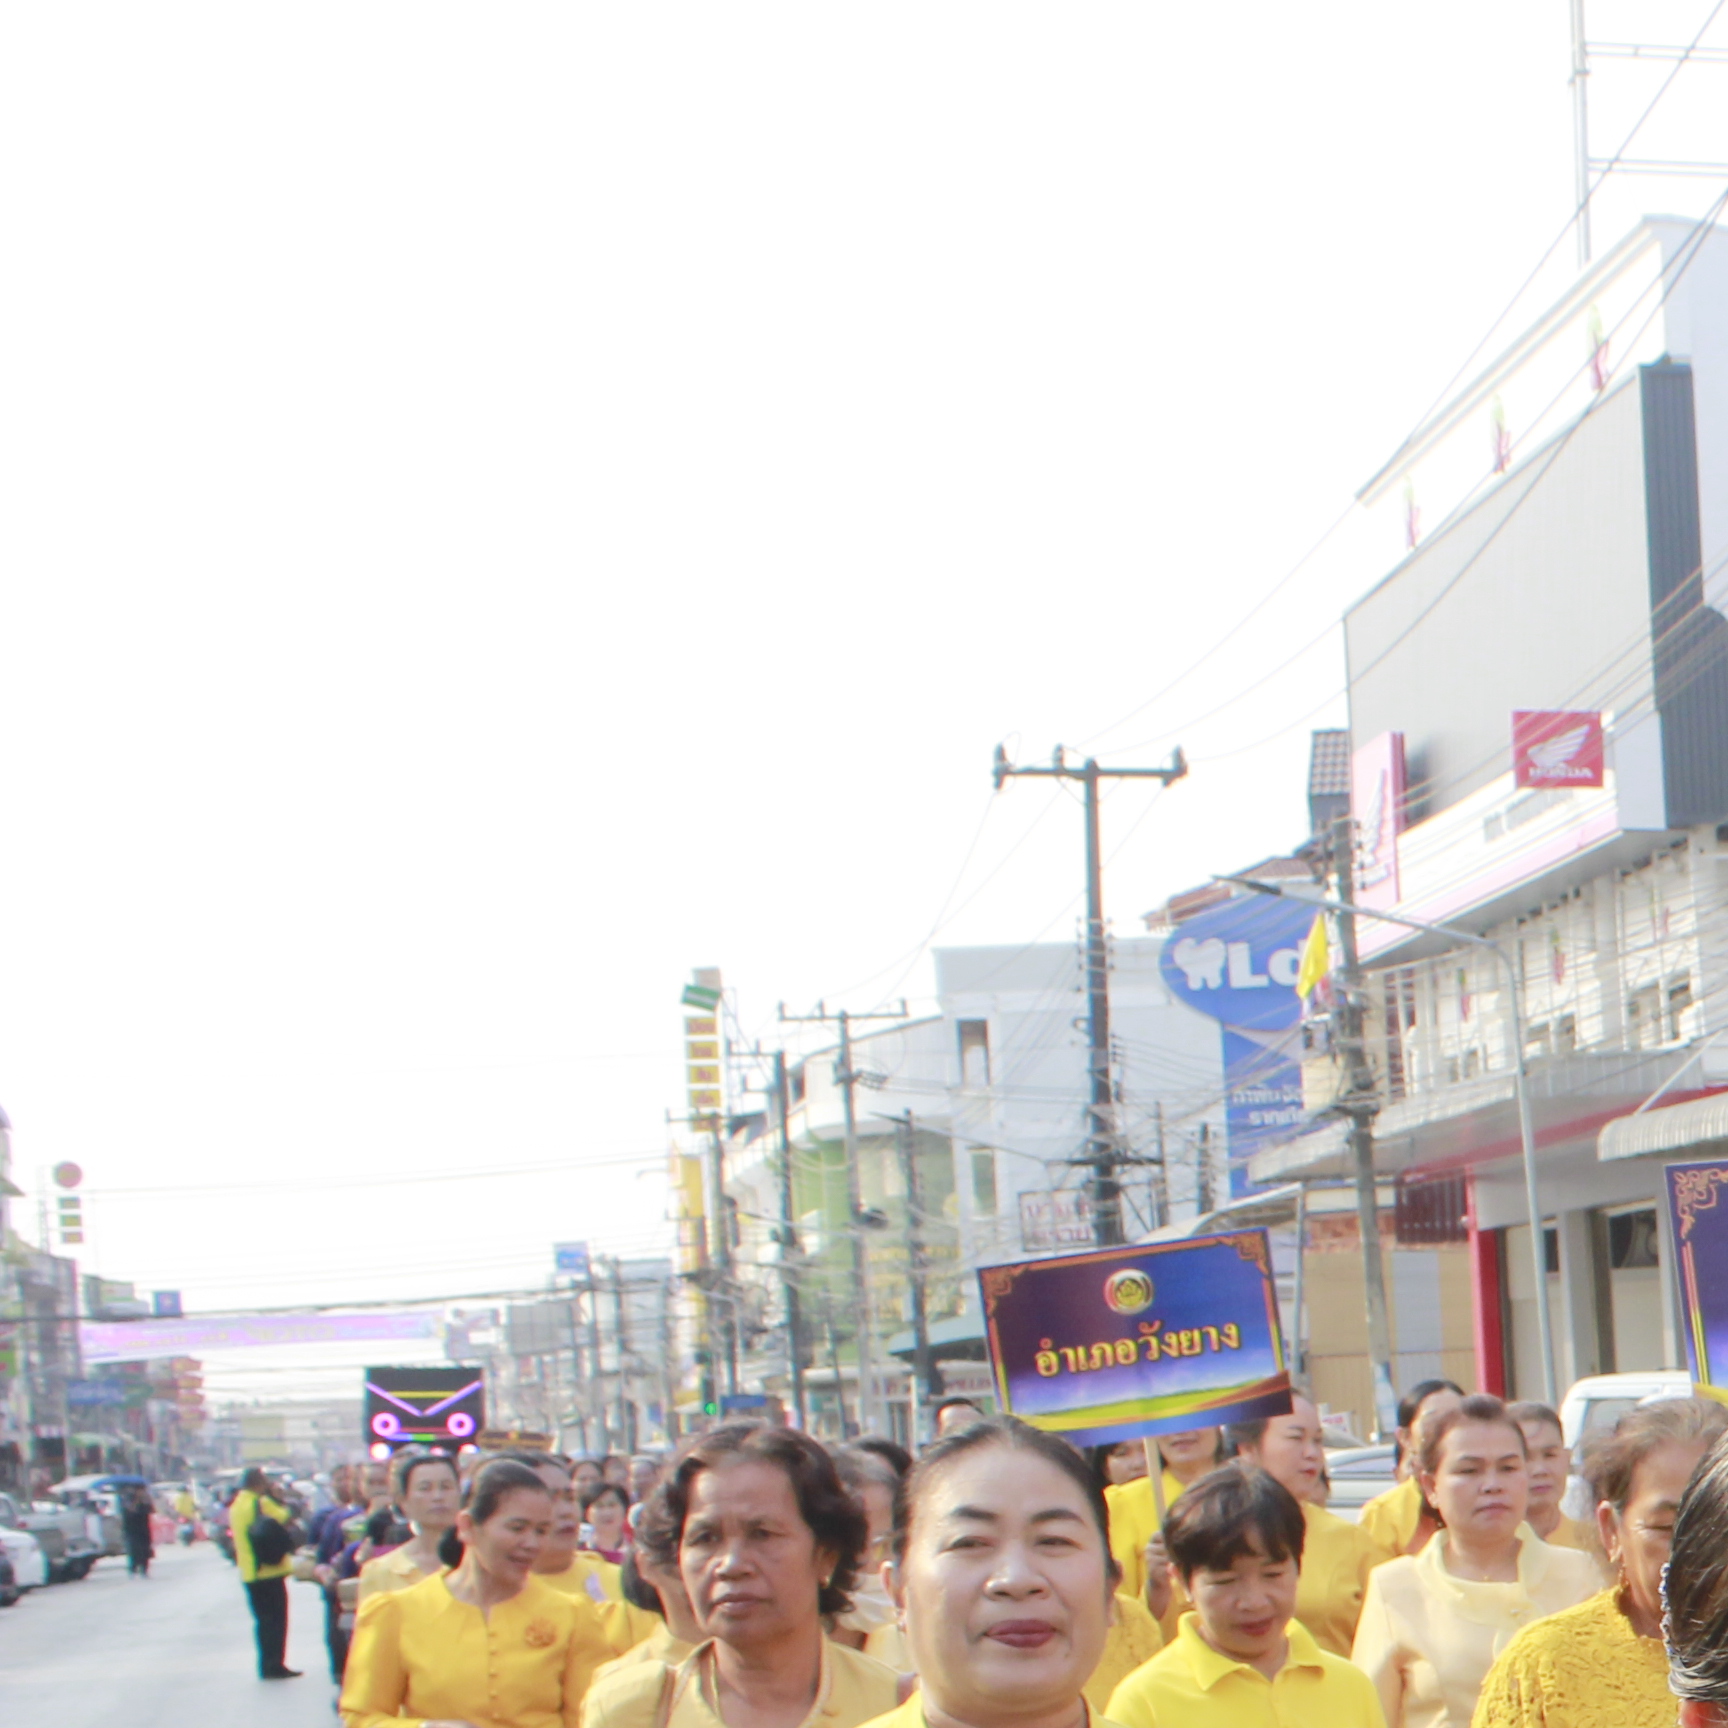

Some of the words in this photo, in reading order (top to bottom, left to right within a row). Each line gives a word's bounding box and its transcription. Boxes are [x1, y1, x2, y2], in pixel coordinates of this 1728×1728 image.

[1527, 766, 1595, 779] HONDA
[1034, 1320, 1241, 1377] อำเภอวังยาง
